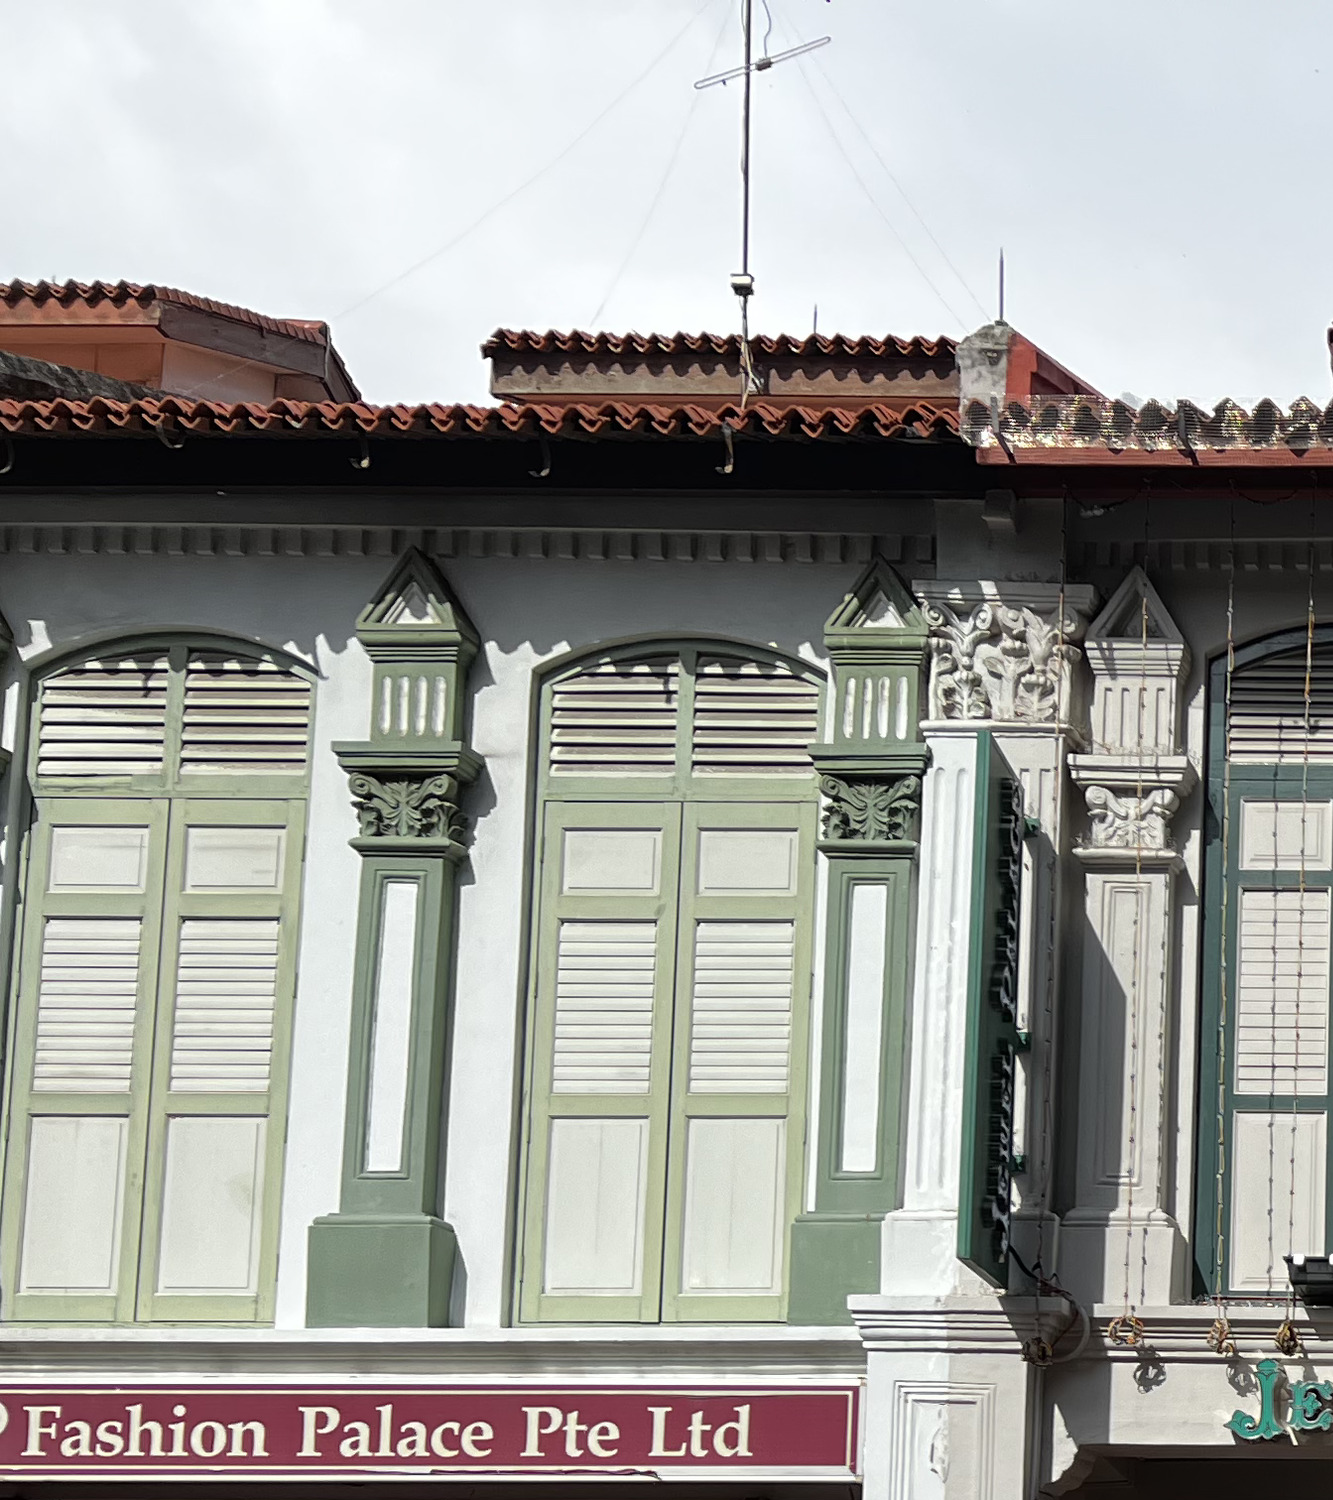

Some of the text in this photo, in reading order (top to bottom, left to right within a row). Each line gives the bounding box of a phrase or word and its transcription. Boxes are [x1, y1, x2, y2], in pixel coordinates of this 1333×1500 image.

[20, 1404, 270, 1458] Fashion
[296, 1403, 494, 1458] Palace
[519, 1406, 621, 1458] Pte
[646, 1403, 754, 1458] Ltd
